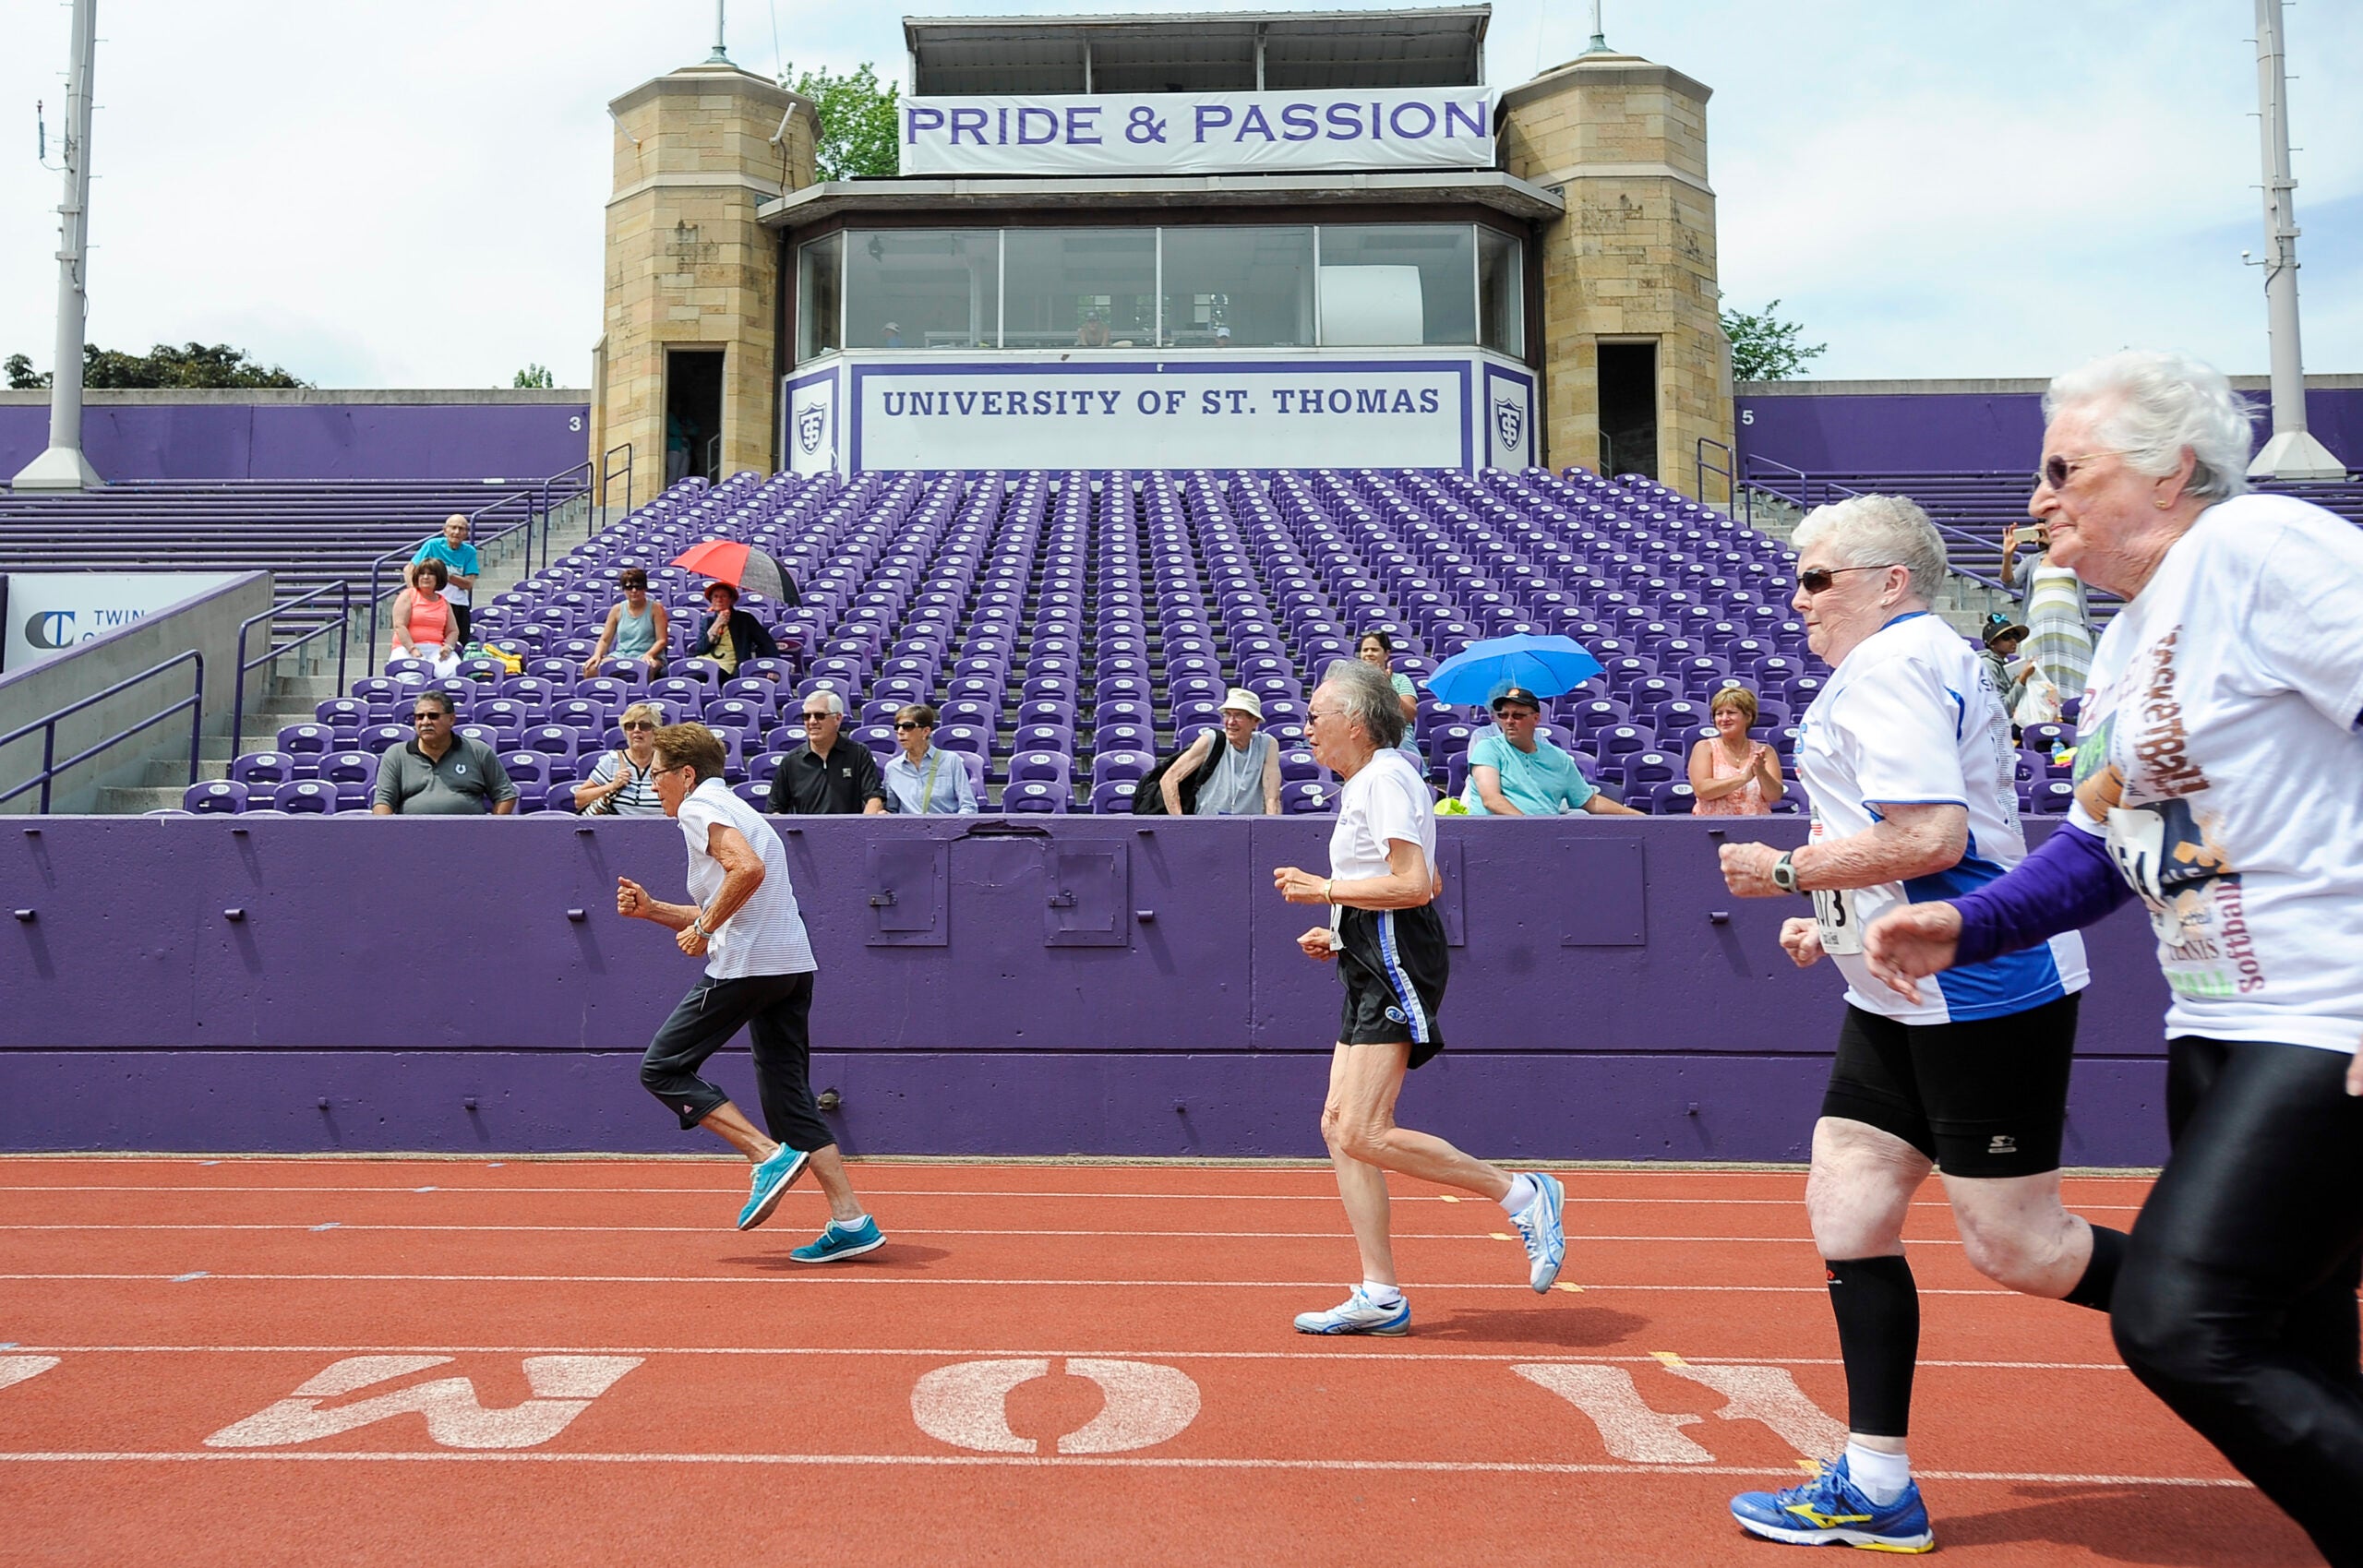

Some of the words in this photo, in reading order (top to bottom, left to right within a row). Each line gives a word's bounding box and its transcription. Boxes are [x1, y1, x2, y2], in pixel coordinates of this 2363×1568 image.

[906, 106, 1102, 145] PRIDE
[1125, 105, 1166, 144] &
[1193, 101, 1486, 143] PASSION
[882, 390, 1121, 415] UNIVERSITY
[1137, 390, 1186, 415] OF
[1202, 389, 1256, 414] ST.
[1273, 389, 1439, 413] THOMAS
[569, 416, 582, 432] 3
[1742, 409, 1755, 425] 5
[2214, 882, 2266, 994] Softball
